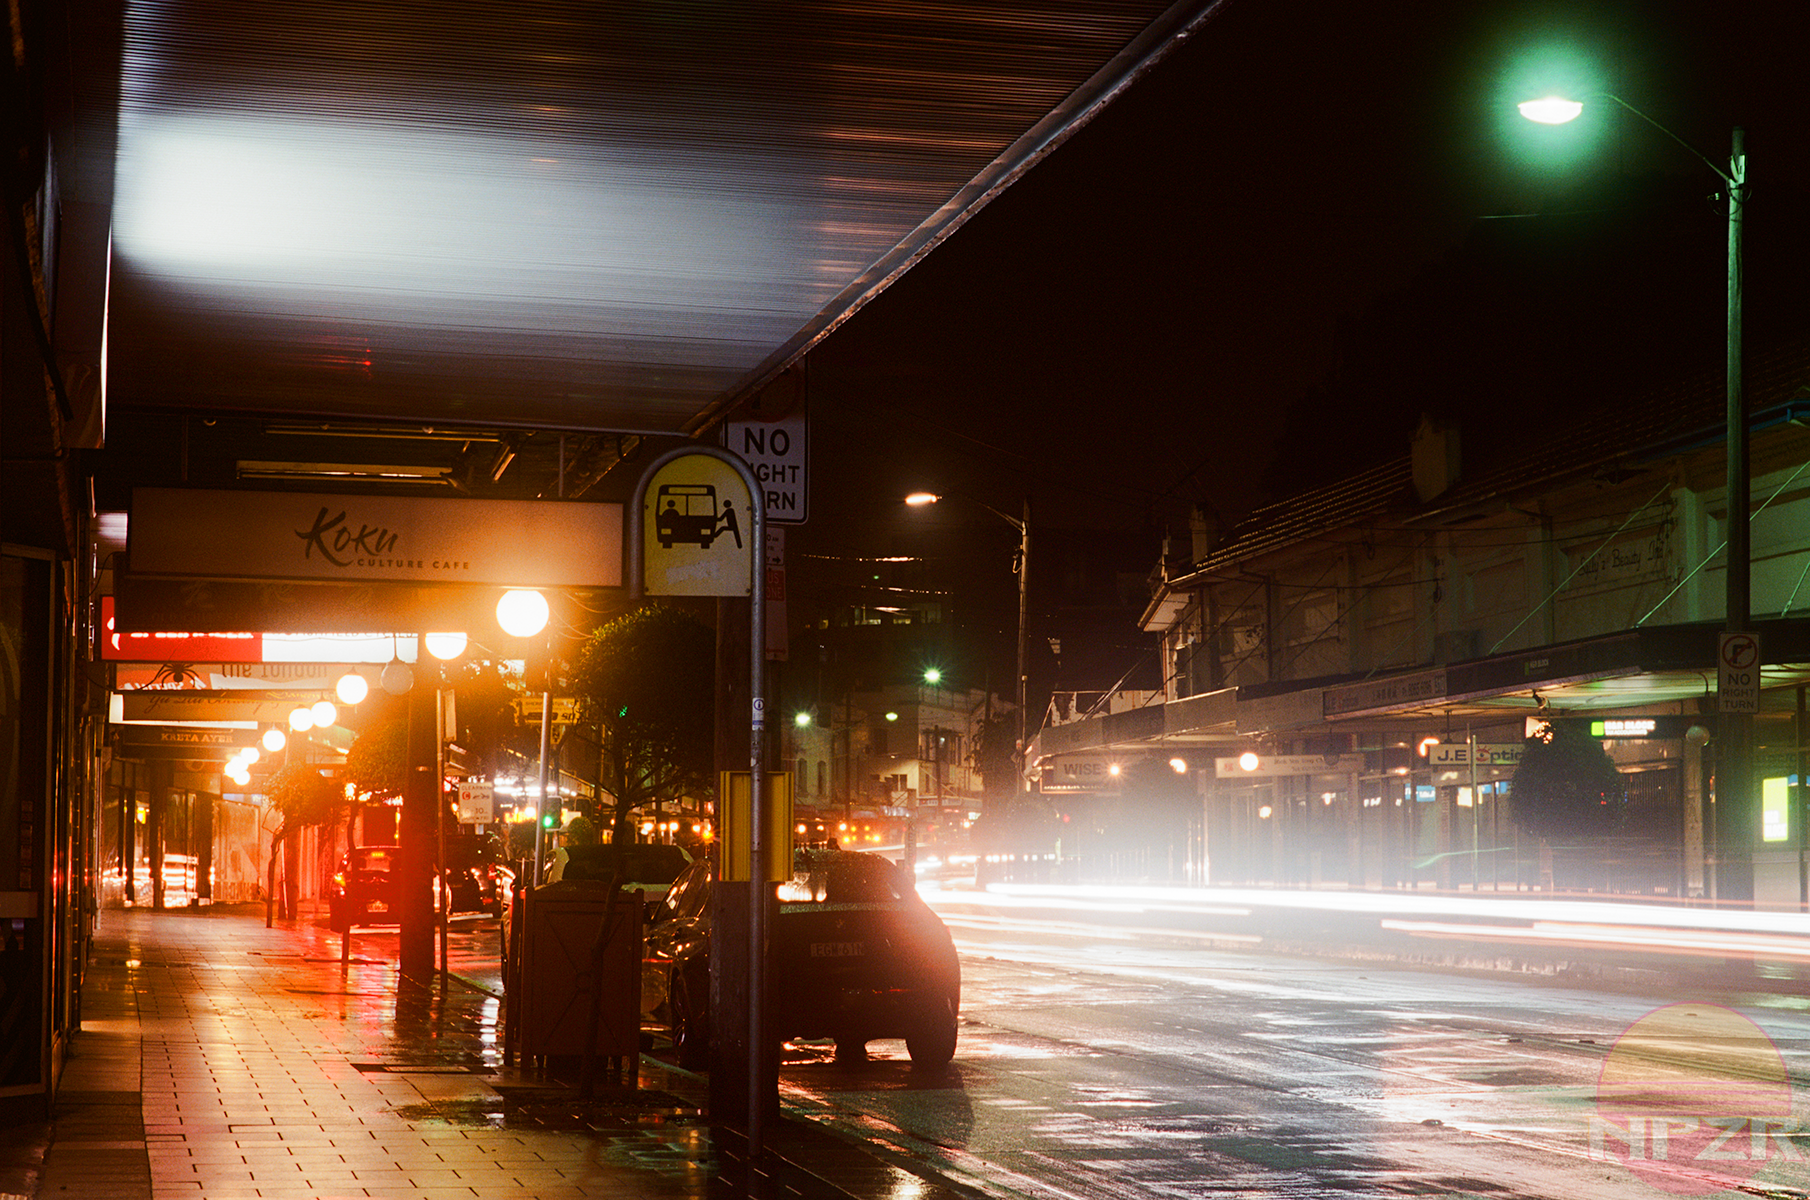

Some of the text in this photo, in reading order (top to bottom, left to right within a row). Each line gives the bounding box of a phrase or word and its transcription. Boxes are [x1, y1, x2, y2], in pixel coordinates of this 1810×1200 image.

[745, 427, 790, 456] NO
[751, 463, 800, 484] GHT
[764, 491, 796, 510] RN
[357, 558, 470, 570] CULTURE CAFE
[767, 572, 780, 584] US
[766, 586, 782, 599] ONE
[1728, 673, 1751, 686] NO
[1722, 688, 1755, 697] RIGHT
[1724, 700, 1754, 709] TURN
[1624, 719, 1656, 732] BLOCK
[161, 733, 233, 744] KRETA AYER
[1437, 746, 1525, 764] J.E Optic
[1064, 763, 1102, 776] WISE
